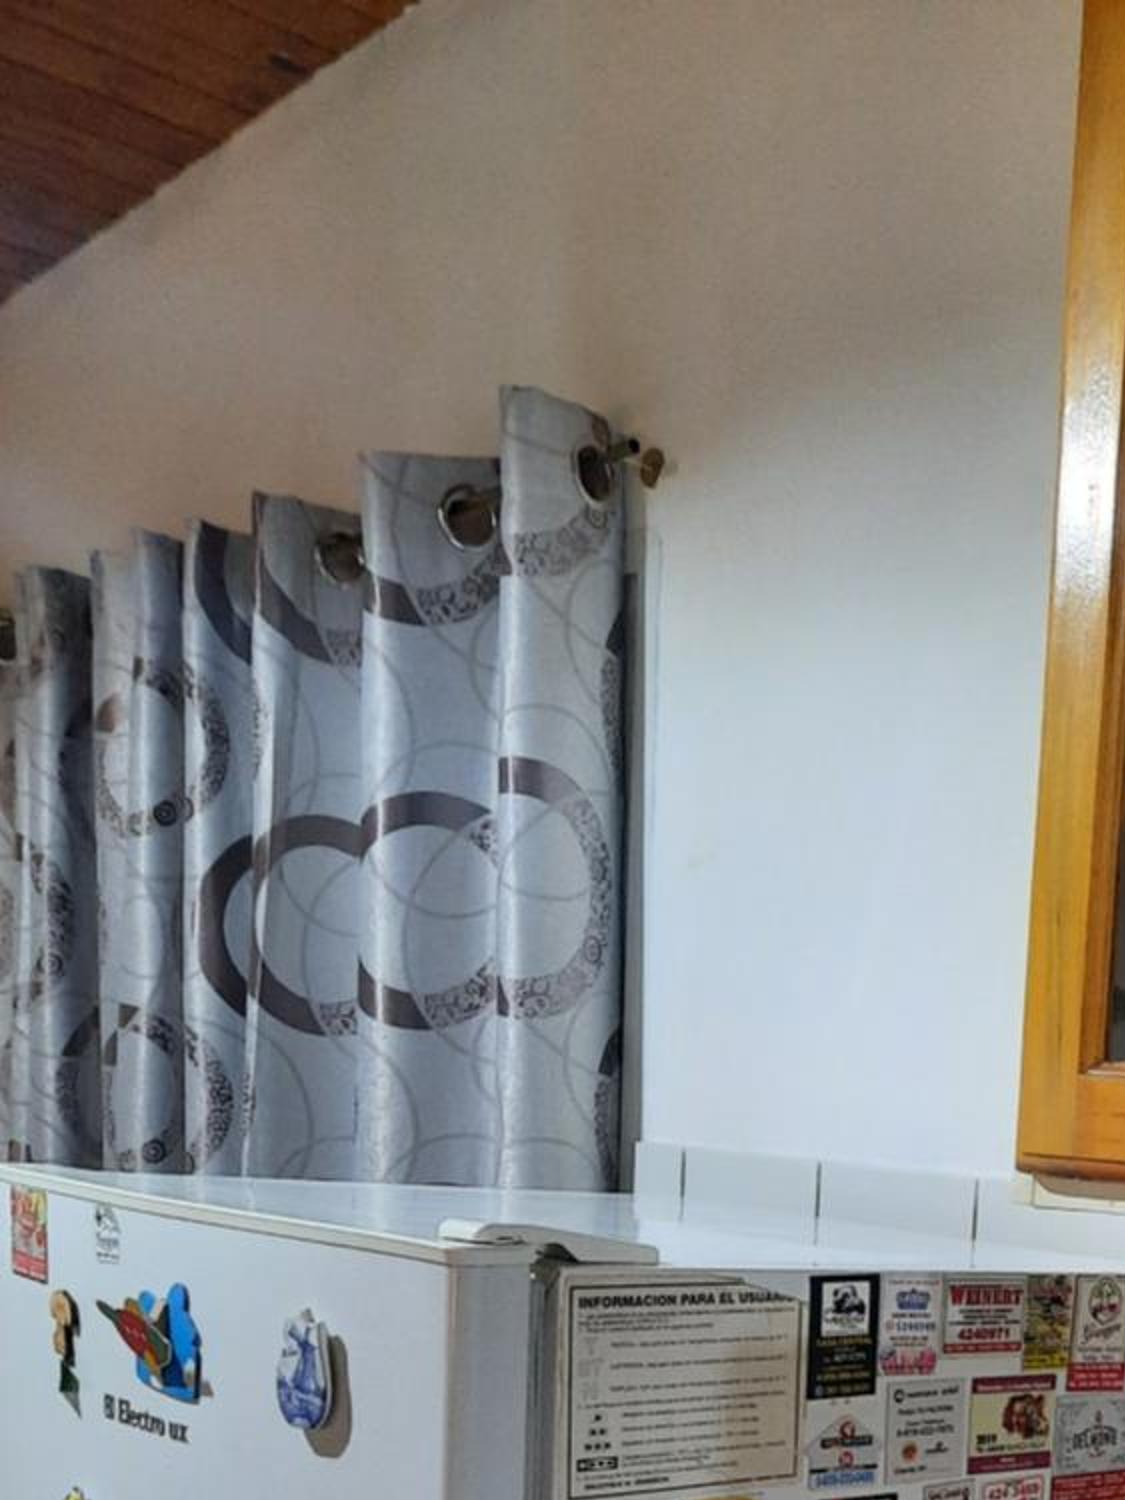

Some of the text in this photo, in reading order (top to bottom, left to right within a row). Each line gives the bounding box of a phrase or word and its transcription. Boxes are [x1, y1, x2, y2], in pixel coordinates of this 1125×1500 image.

[578, 1295, 677, 1310] INFORMACION
[680, 1294, 716, 1307] PARA
[719, 1292, 735, 1305] EL
